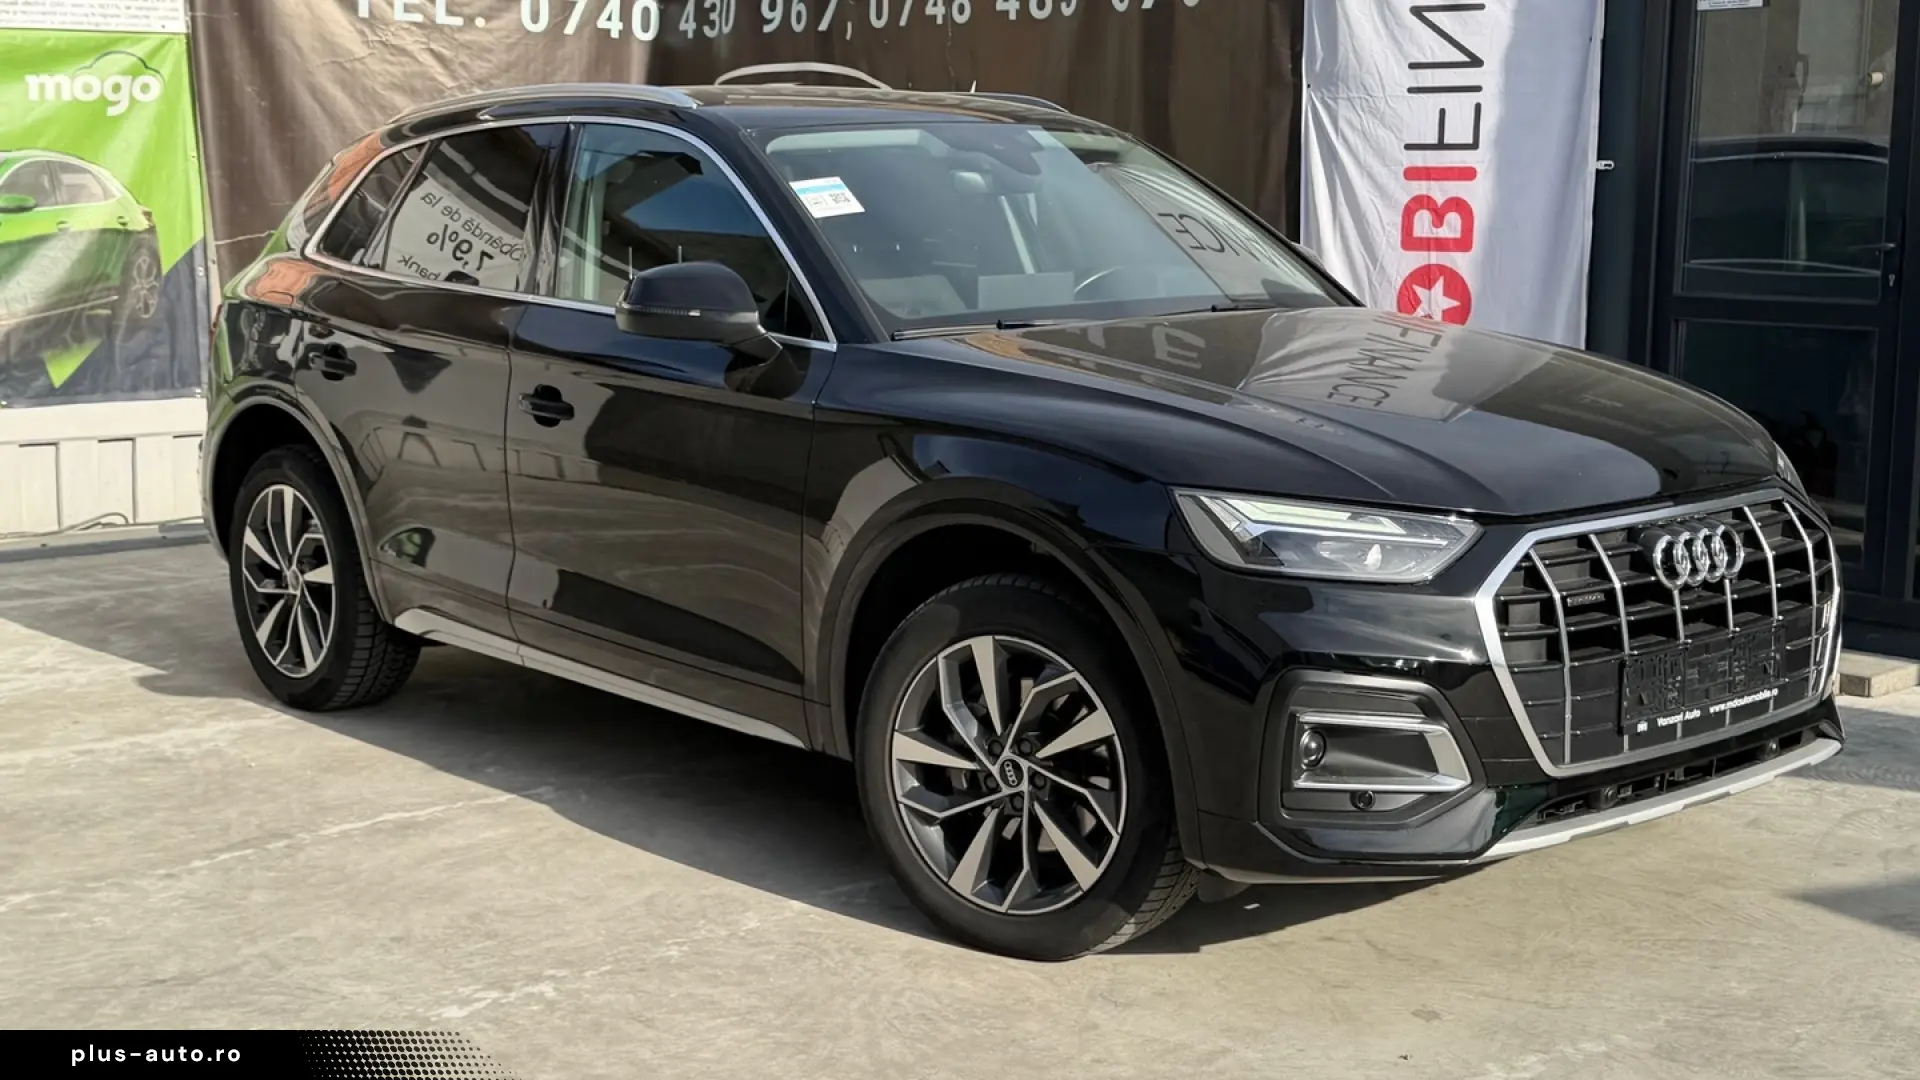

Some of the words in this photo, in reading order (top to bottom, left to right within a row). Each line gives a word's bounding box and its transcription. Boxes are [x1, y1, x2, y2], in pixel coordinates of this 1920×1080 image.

[520, 0, 660, 41] 0740
[678, 0, 735, 39] 430
[760, 0, 853, 41] 967,
[24, 69, 163, 117] mogo
[1684, 709, 1701, 721] Auto
